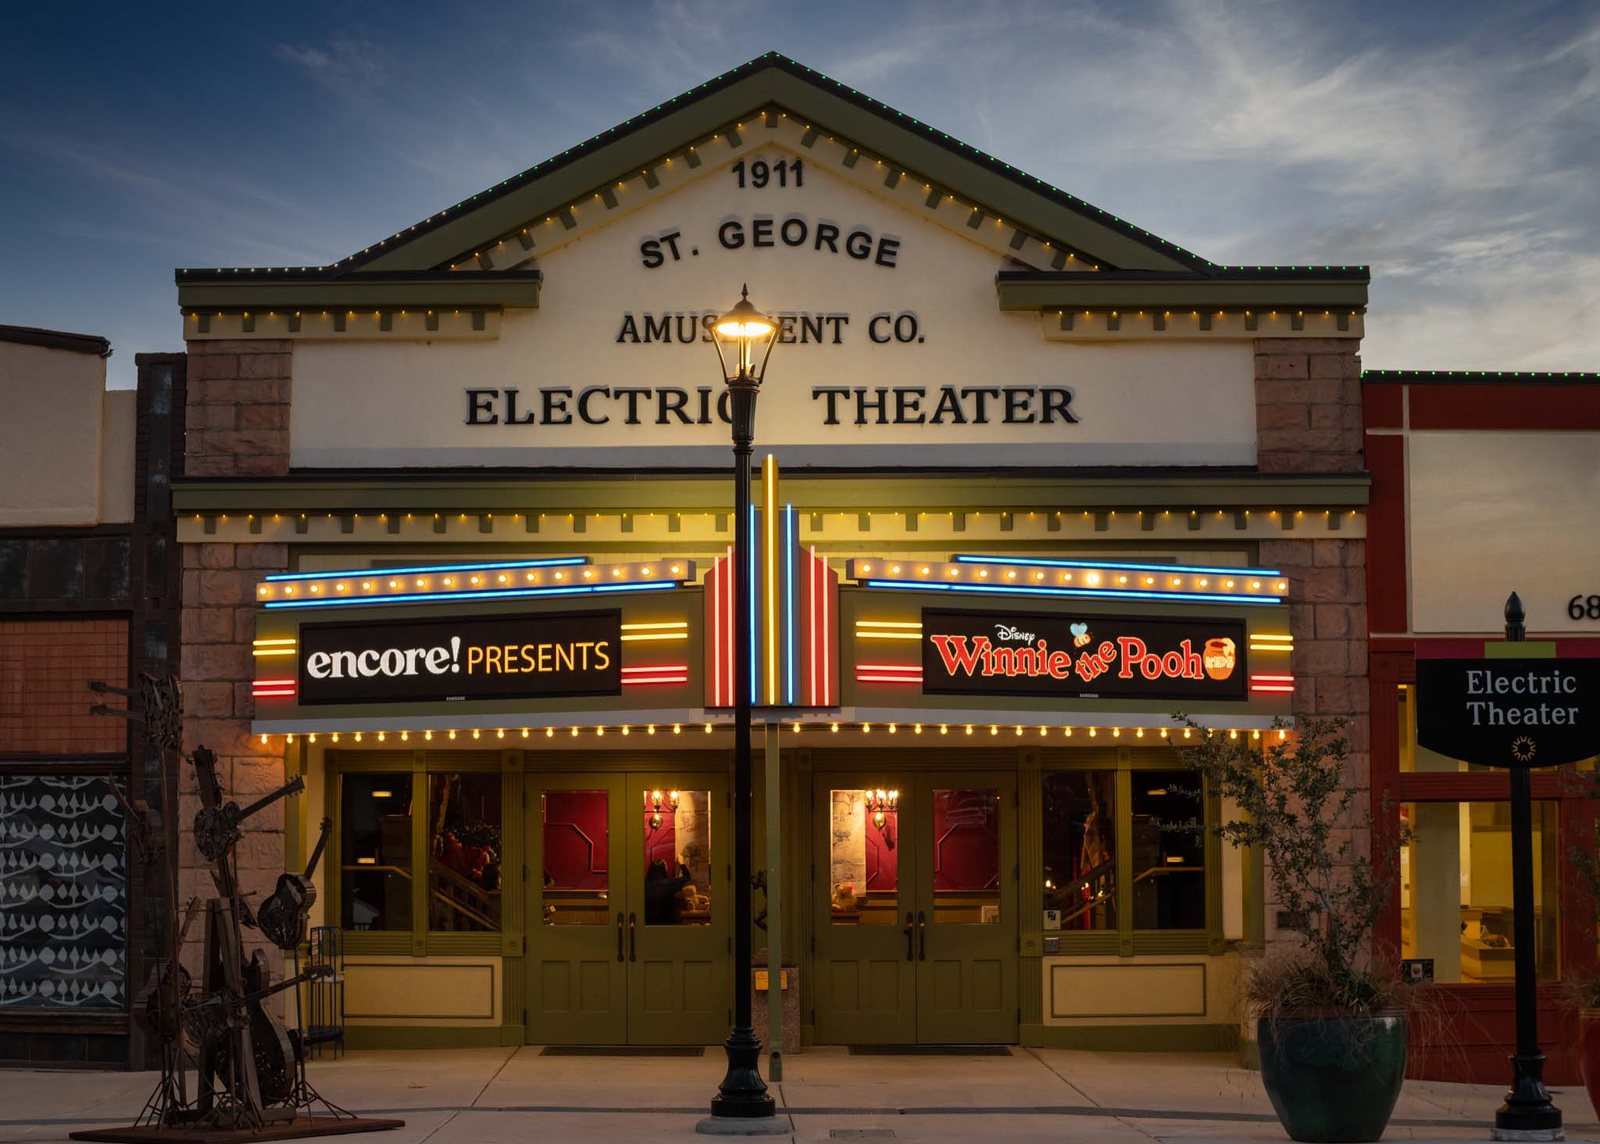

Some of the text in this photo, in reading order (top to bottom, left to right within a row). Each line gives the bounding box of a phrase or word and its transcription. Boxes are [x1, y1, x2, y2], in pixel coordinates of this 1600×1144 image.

[731, 159, 803, 188] 1911
[640, 218, 900, 269] ST. GEORGE
[616, 314, 925, 344] AMUSENT CO.
[812, 387, 1079, 425] THEATER
[994, 623, 1036, 646] Disney
[306, 636, 611, 679] encore! PRESENTS
[930, 634, 1205, 683] Winnie the Pooh
[1466, 670, 1577, 695] Electric
[1466, 701, 1579, 726] Theater
